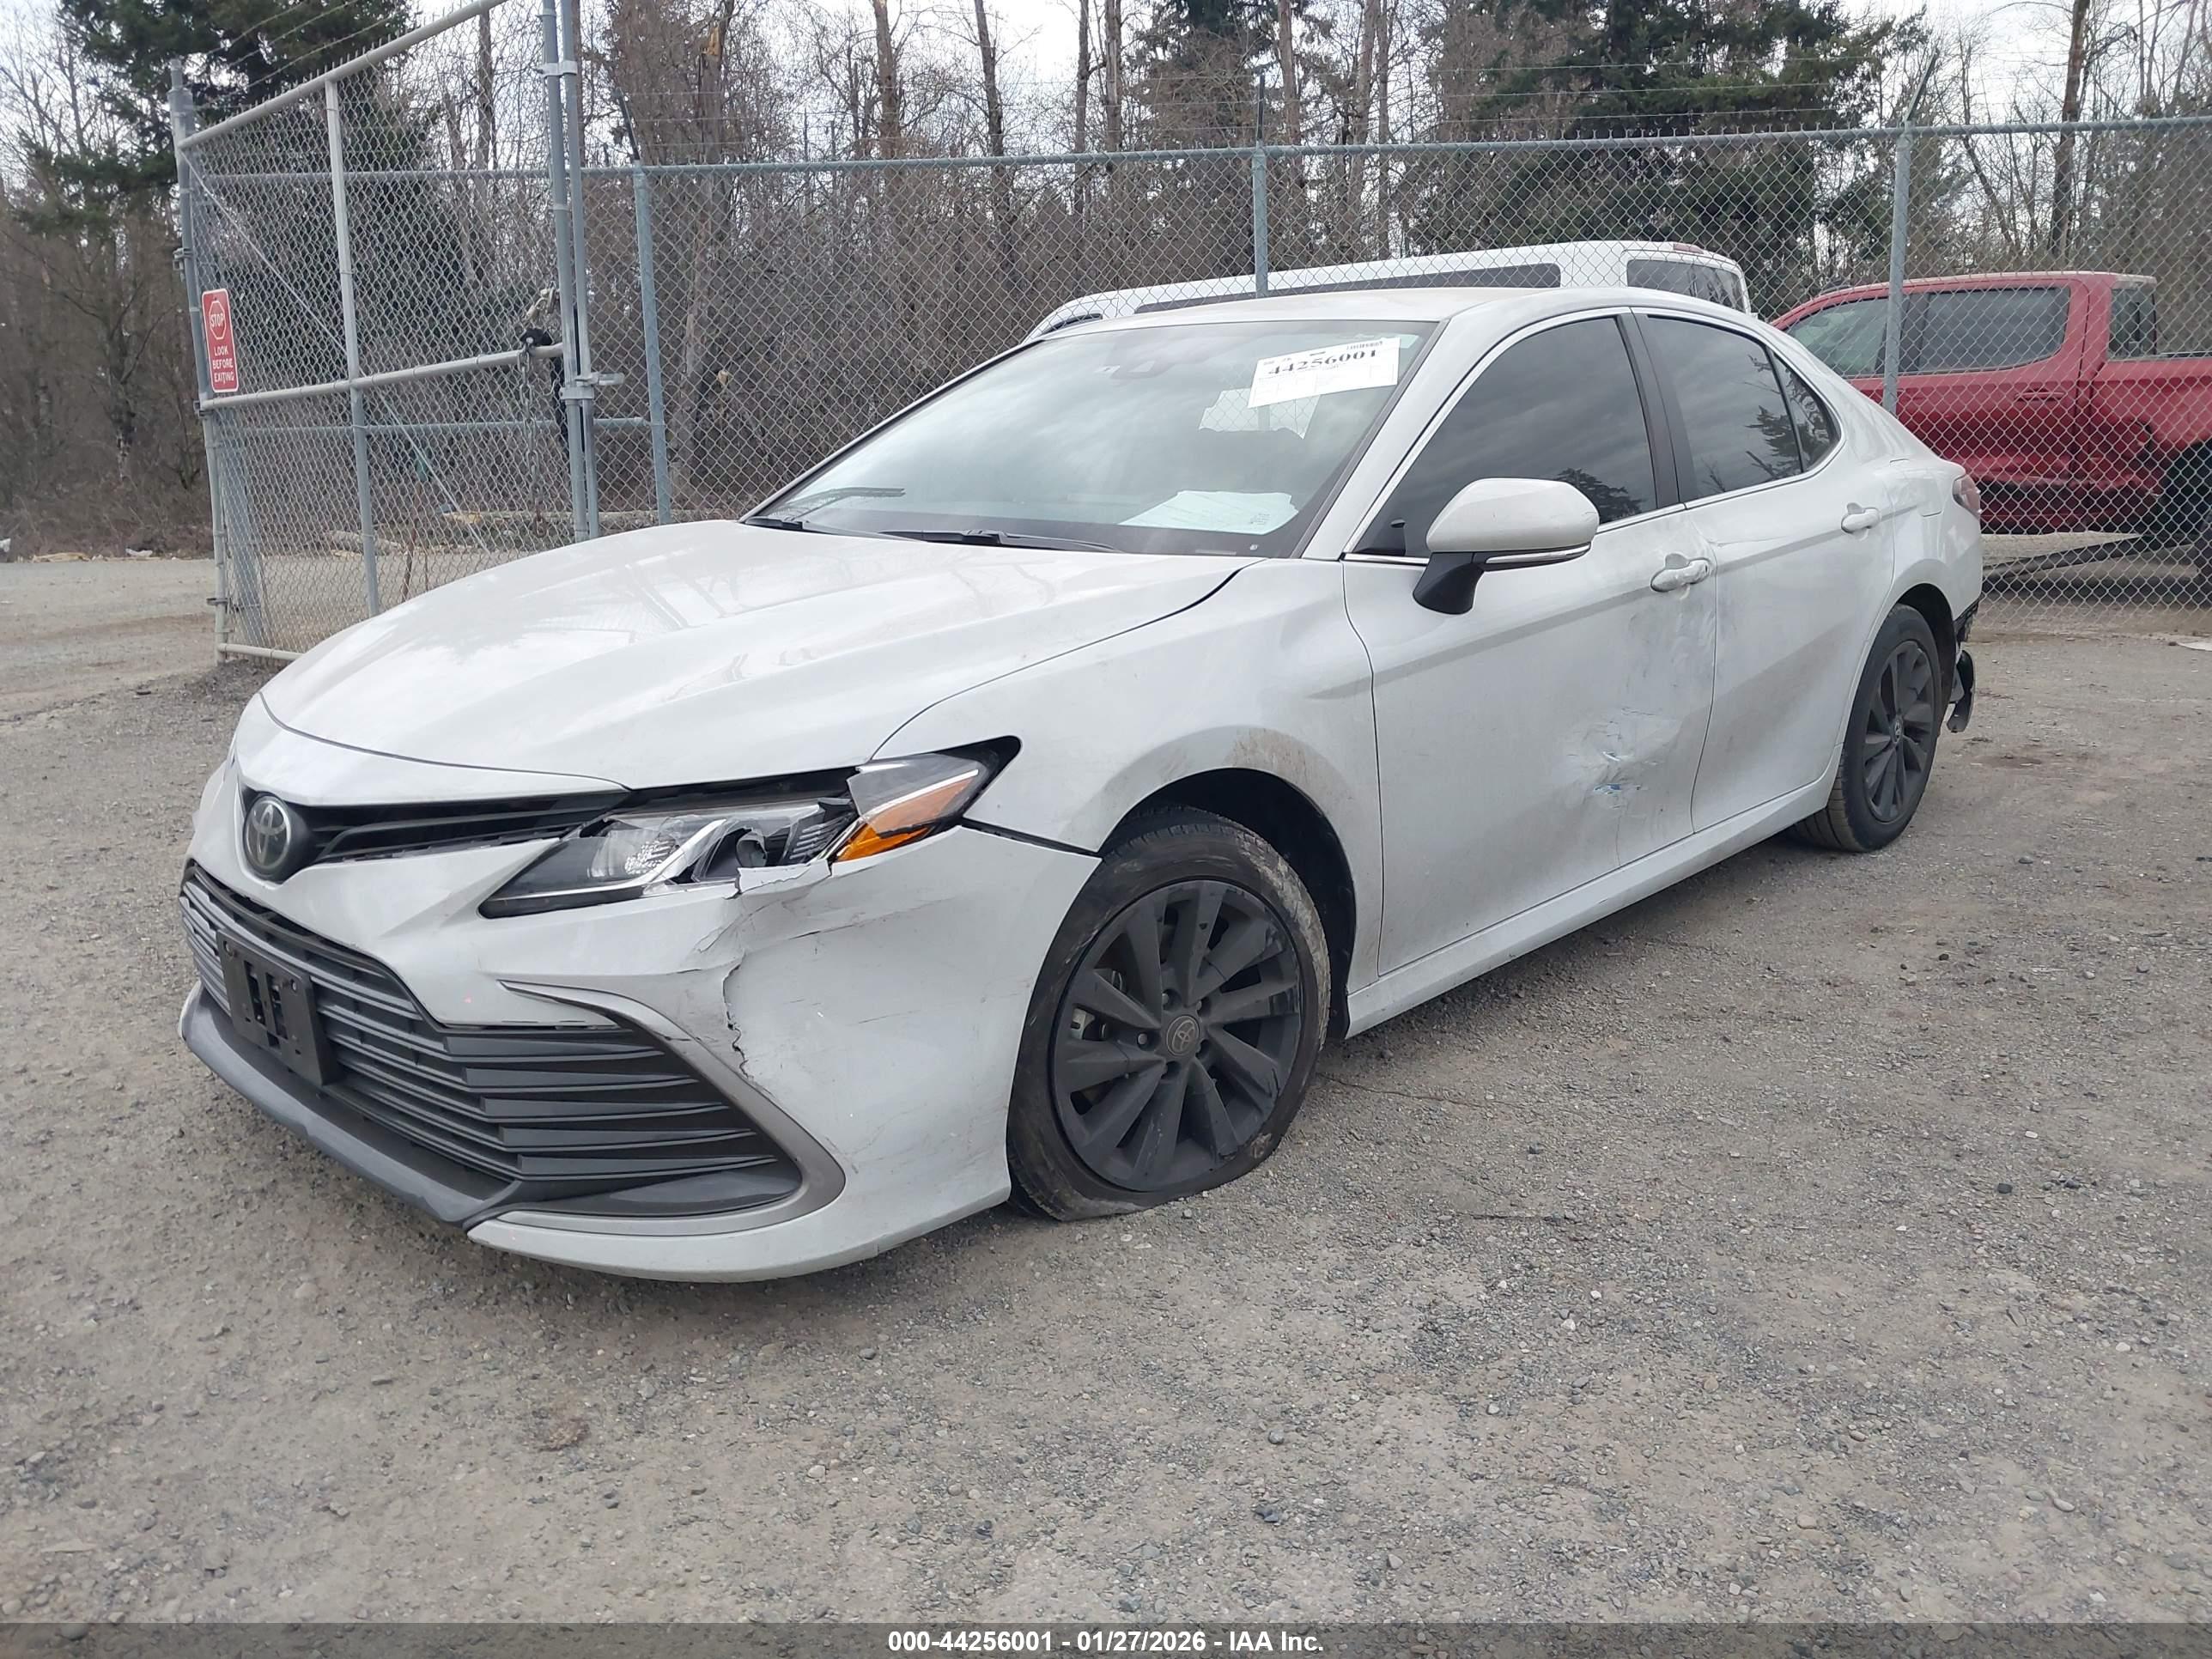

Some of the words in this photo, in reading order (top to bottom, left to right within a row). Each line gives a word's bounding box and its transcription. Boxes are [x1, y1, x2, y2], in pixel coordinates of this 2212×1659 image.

[210, 313, 225, 328] STOP
[214, 345, 228, 356] LOOK
[212, 357, 234, 369] BEFORE
[1268, 349, 1376, 374] 44256001
[214, 372, 234, 383] EXITING
